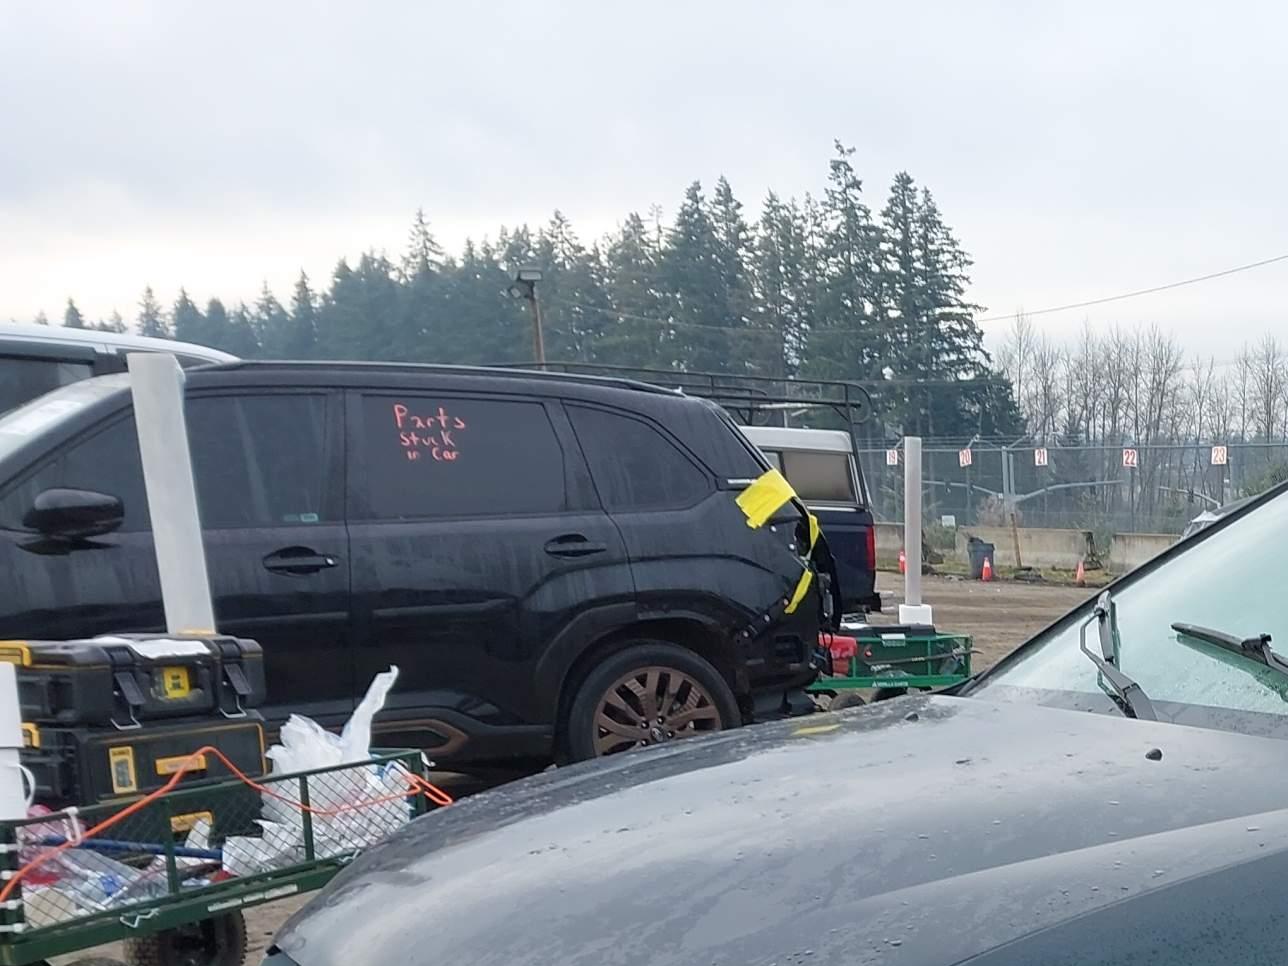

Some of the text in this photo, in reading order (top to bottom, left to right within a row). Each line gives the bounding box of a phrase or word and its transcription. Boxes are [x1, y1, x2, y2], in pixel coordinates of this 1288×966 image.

[394, 404, 466, 429] Parts
[961, 449, 971, 465] 20
[1037, 449, 1046, 465] 21
[1124, 450, 1136, 465] 22
[1213, 447, 1225, 463] 23
